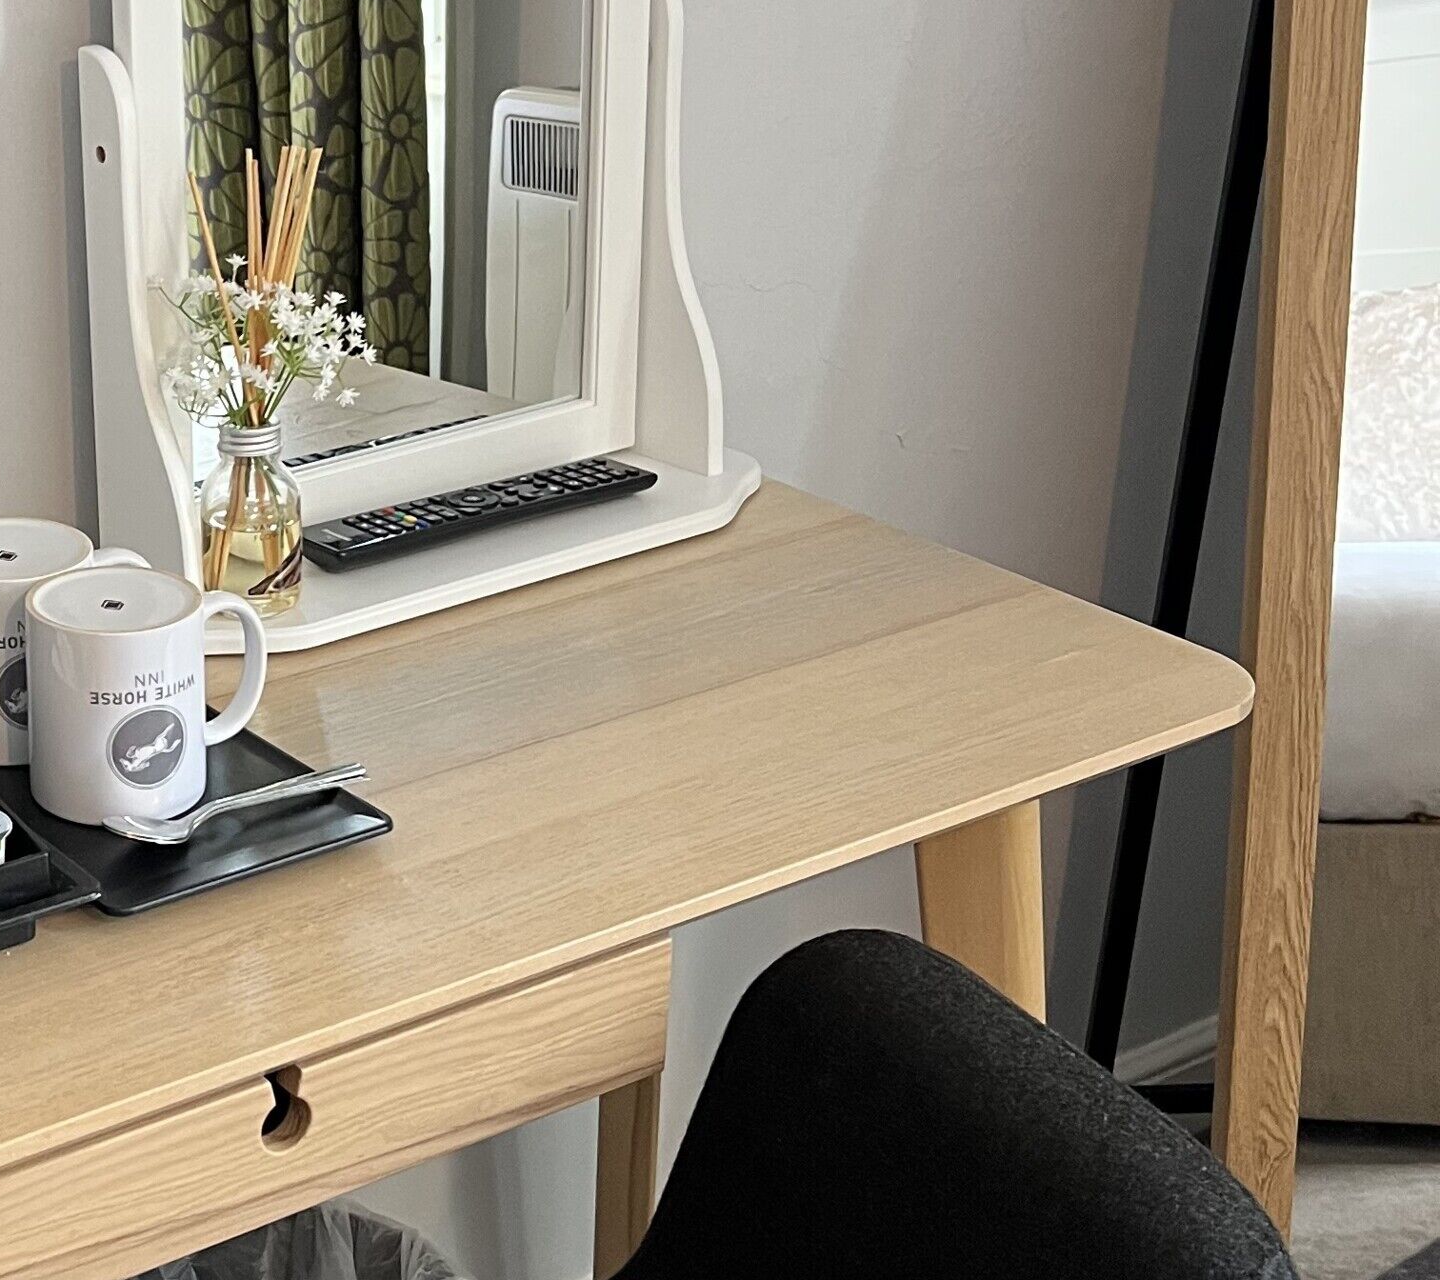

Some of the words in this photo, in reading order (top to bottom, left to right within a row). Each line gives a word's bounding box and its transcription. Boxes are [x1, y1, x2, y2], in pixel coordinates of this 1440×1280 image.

[134, 669, 165, 688] INN
[154, 673, 195, 701] WHITE
[89, 689, 148, 706] HORSE
